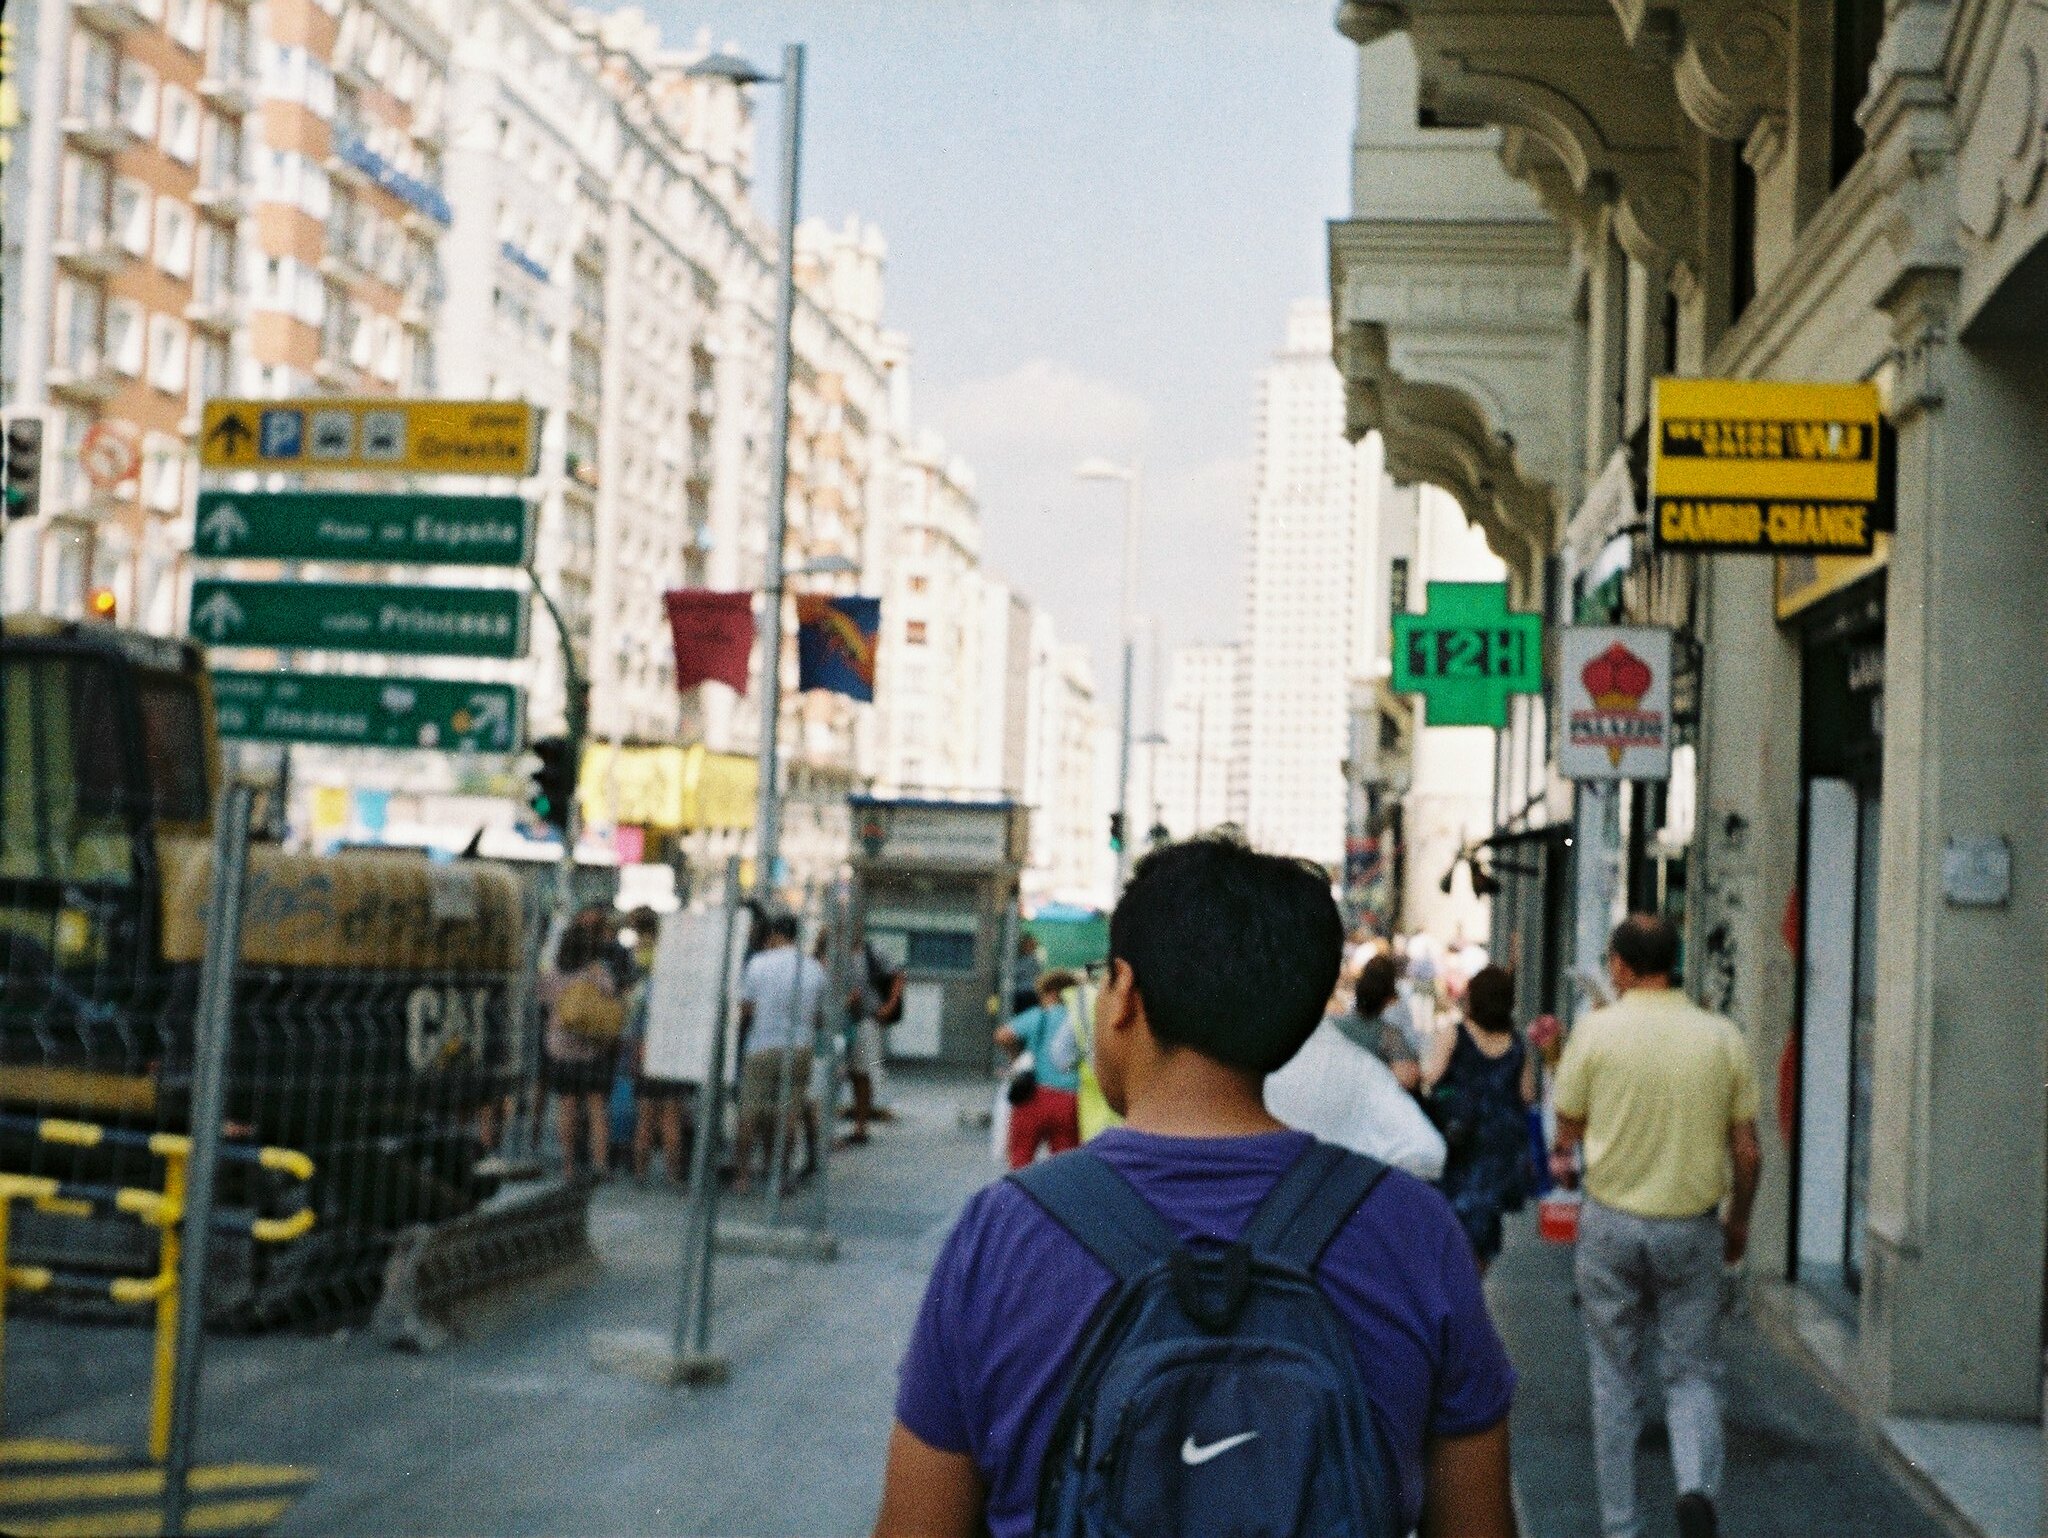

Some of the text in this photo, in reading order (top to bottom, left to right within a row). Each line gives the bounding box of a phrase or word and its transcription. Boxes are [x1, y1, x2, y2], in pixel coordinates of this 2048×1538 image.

[413, 514, 518, 549] España
[378, 601, 512, 637] Princesa
[1411, 628, 1523, 677] 12H
